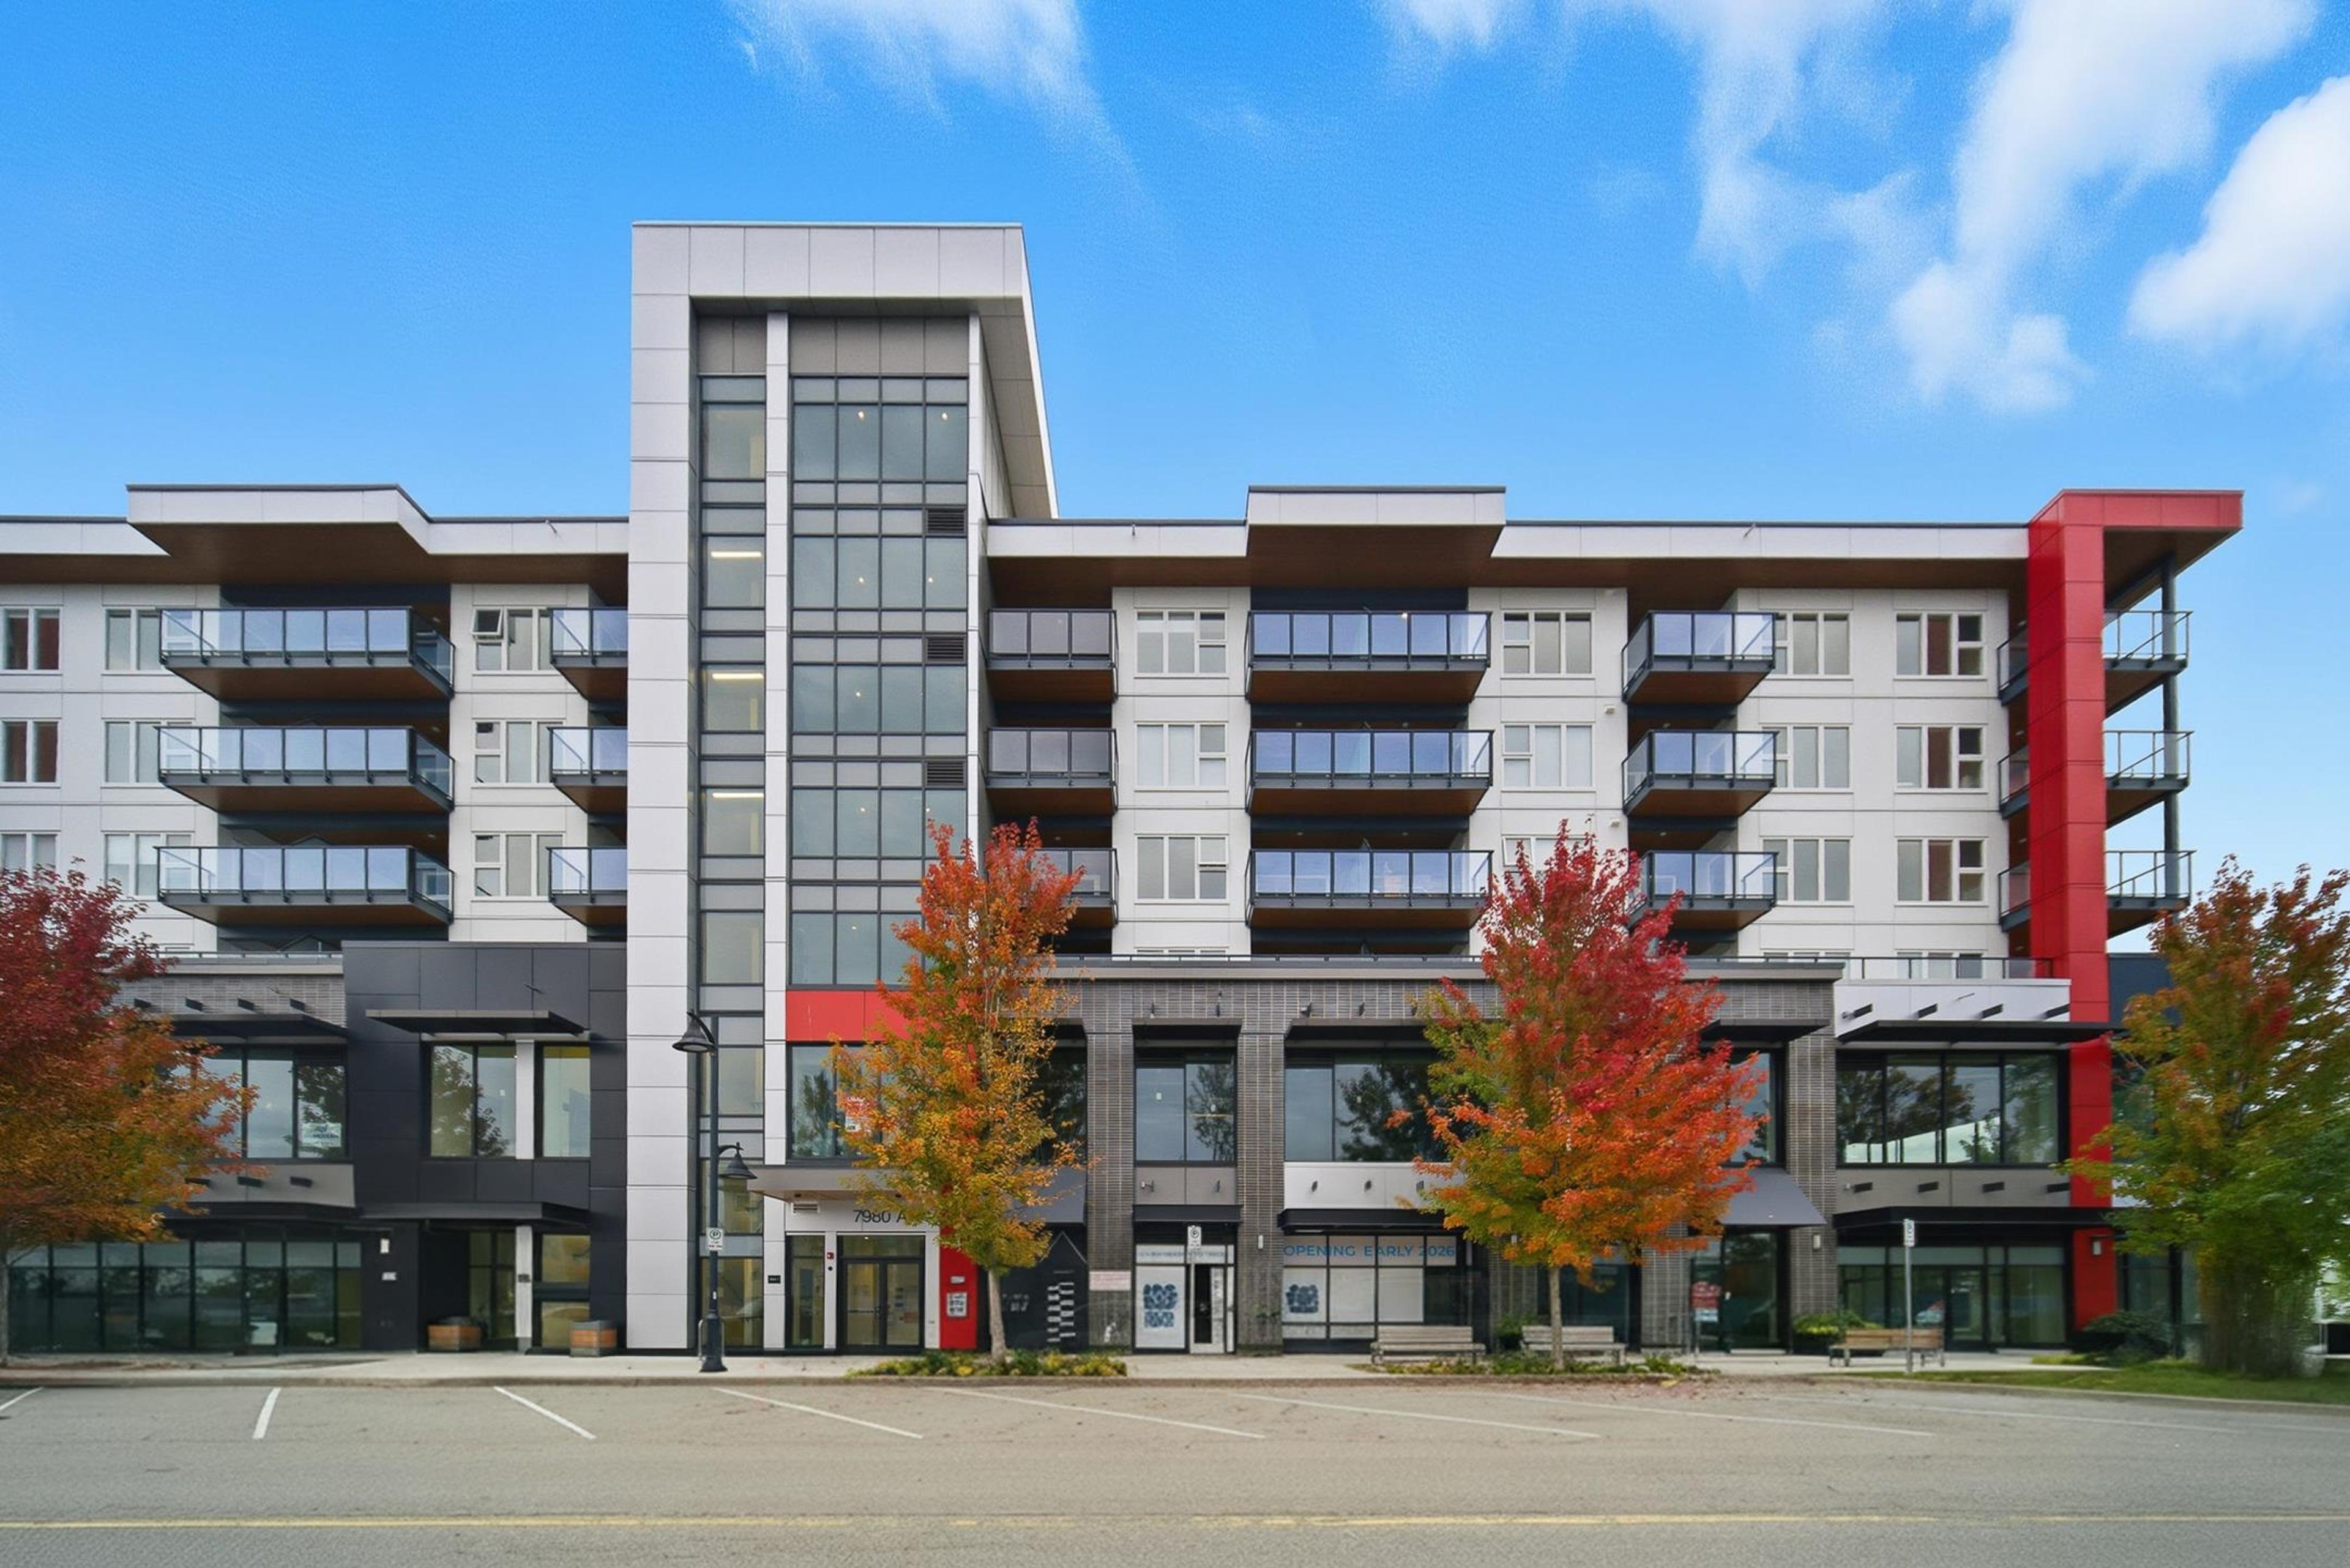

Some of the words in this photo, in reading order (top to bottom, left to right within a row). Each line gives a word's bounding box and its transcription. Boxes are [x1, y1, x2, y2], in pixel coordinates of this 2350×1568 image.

[853, 1209, 890, 1223] 7980
[1364, 1245, 1413, 1256] EARLY
[1419, 1245, 1455, 1256] 2026
